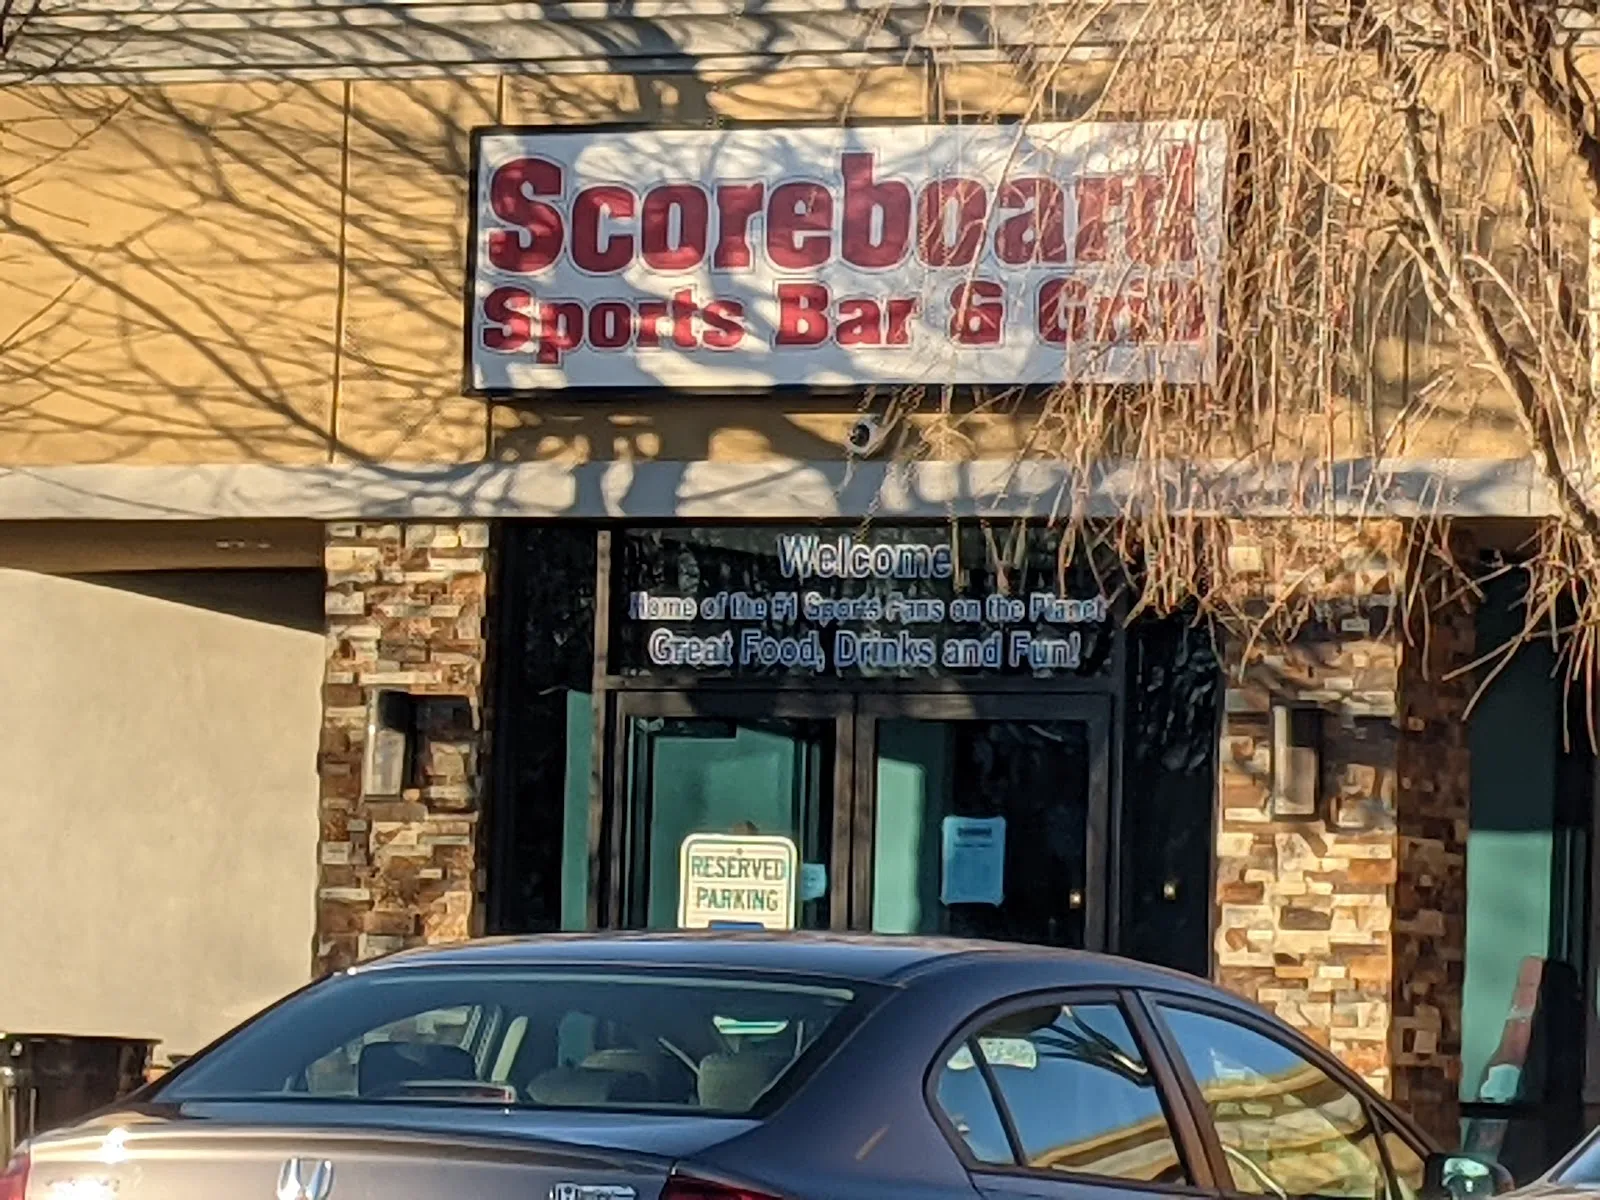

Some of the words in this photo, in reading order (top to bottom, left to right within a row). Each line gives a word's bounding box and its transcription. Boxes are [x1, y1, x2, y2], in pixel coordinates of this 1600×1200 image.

[487, 145, 1197, 273] Scoreboard
[482, 285, 744, 365] Sports
[773, 283, 918, 346] Bar
[950, 280, 1004, 345] &
[777, 535, 951, 578] Welcome
[629, 591, 698, 620] Home
[700, 591, 727, 620] of
[729, 591, 768, 621] the
[803, 591, 882, 626] Sports
[885, 592, 945, 623] Fans
[950, 598, 982, 622] on
[985, 593, 1026, 622] the
[1028, 591, 1107, 623] Planet
[648, 628, 734, 666] Great
[739, 629, 826, 673] Food,
[834, 629, 937, 668] Drinks
[941, 631, 1002, 668] and
[1007, 630, 1082, 669] Fun!
[690, 854, 786, 881] RESERVED
[695, 886, 780, 912] PARKING
